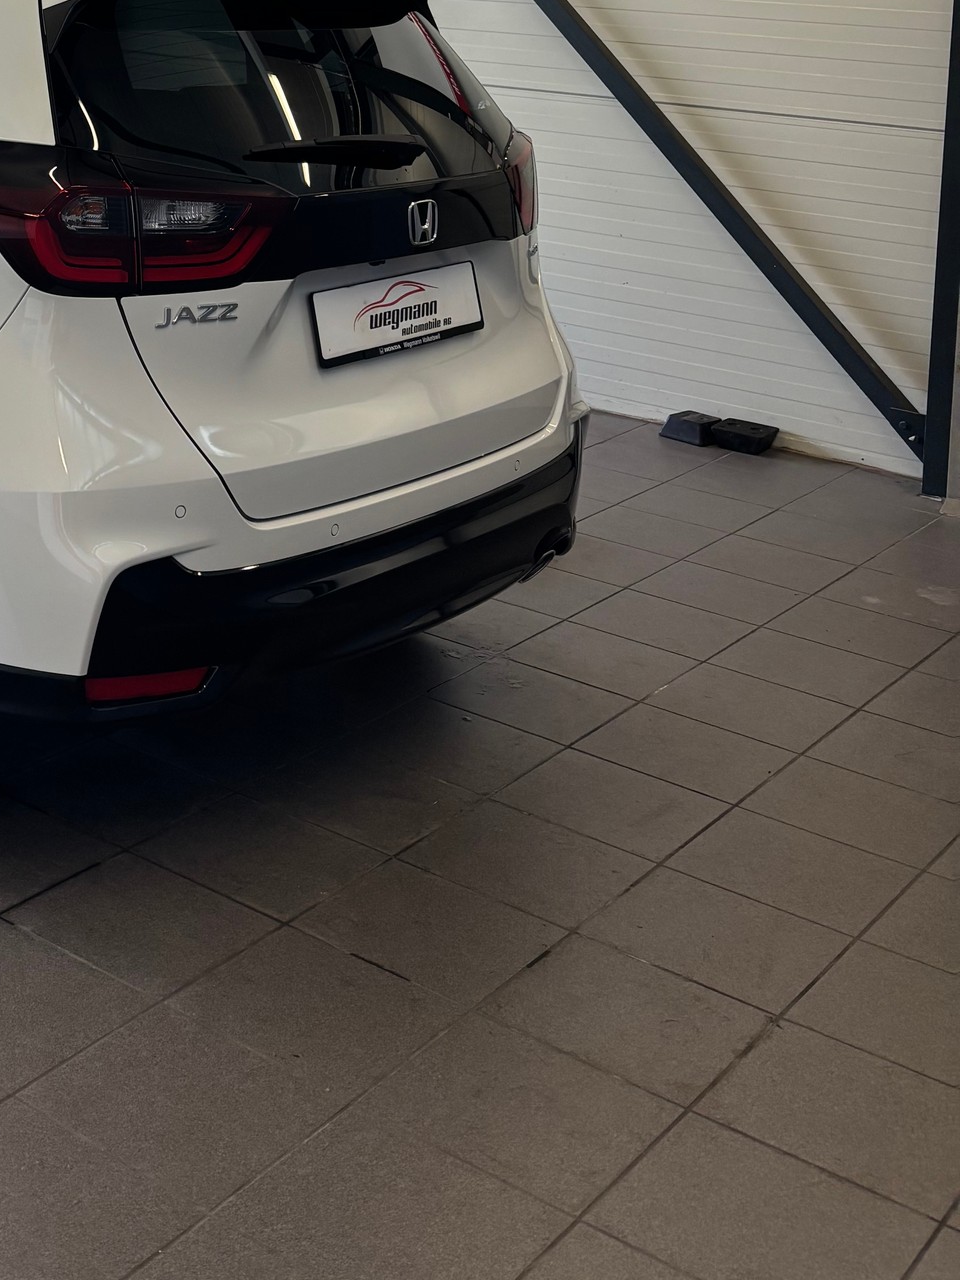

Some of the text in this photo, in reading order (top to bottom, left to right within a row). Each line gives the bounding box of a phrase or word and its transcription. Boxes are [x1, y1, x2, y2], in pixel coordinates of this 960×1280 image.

[155, 303, 238, 329] JAZZ
[370, 300, 437, 330] wegmann
[443, 317, 452, 326] AG
